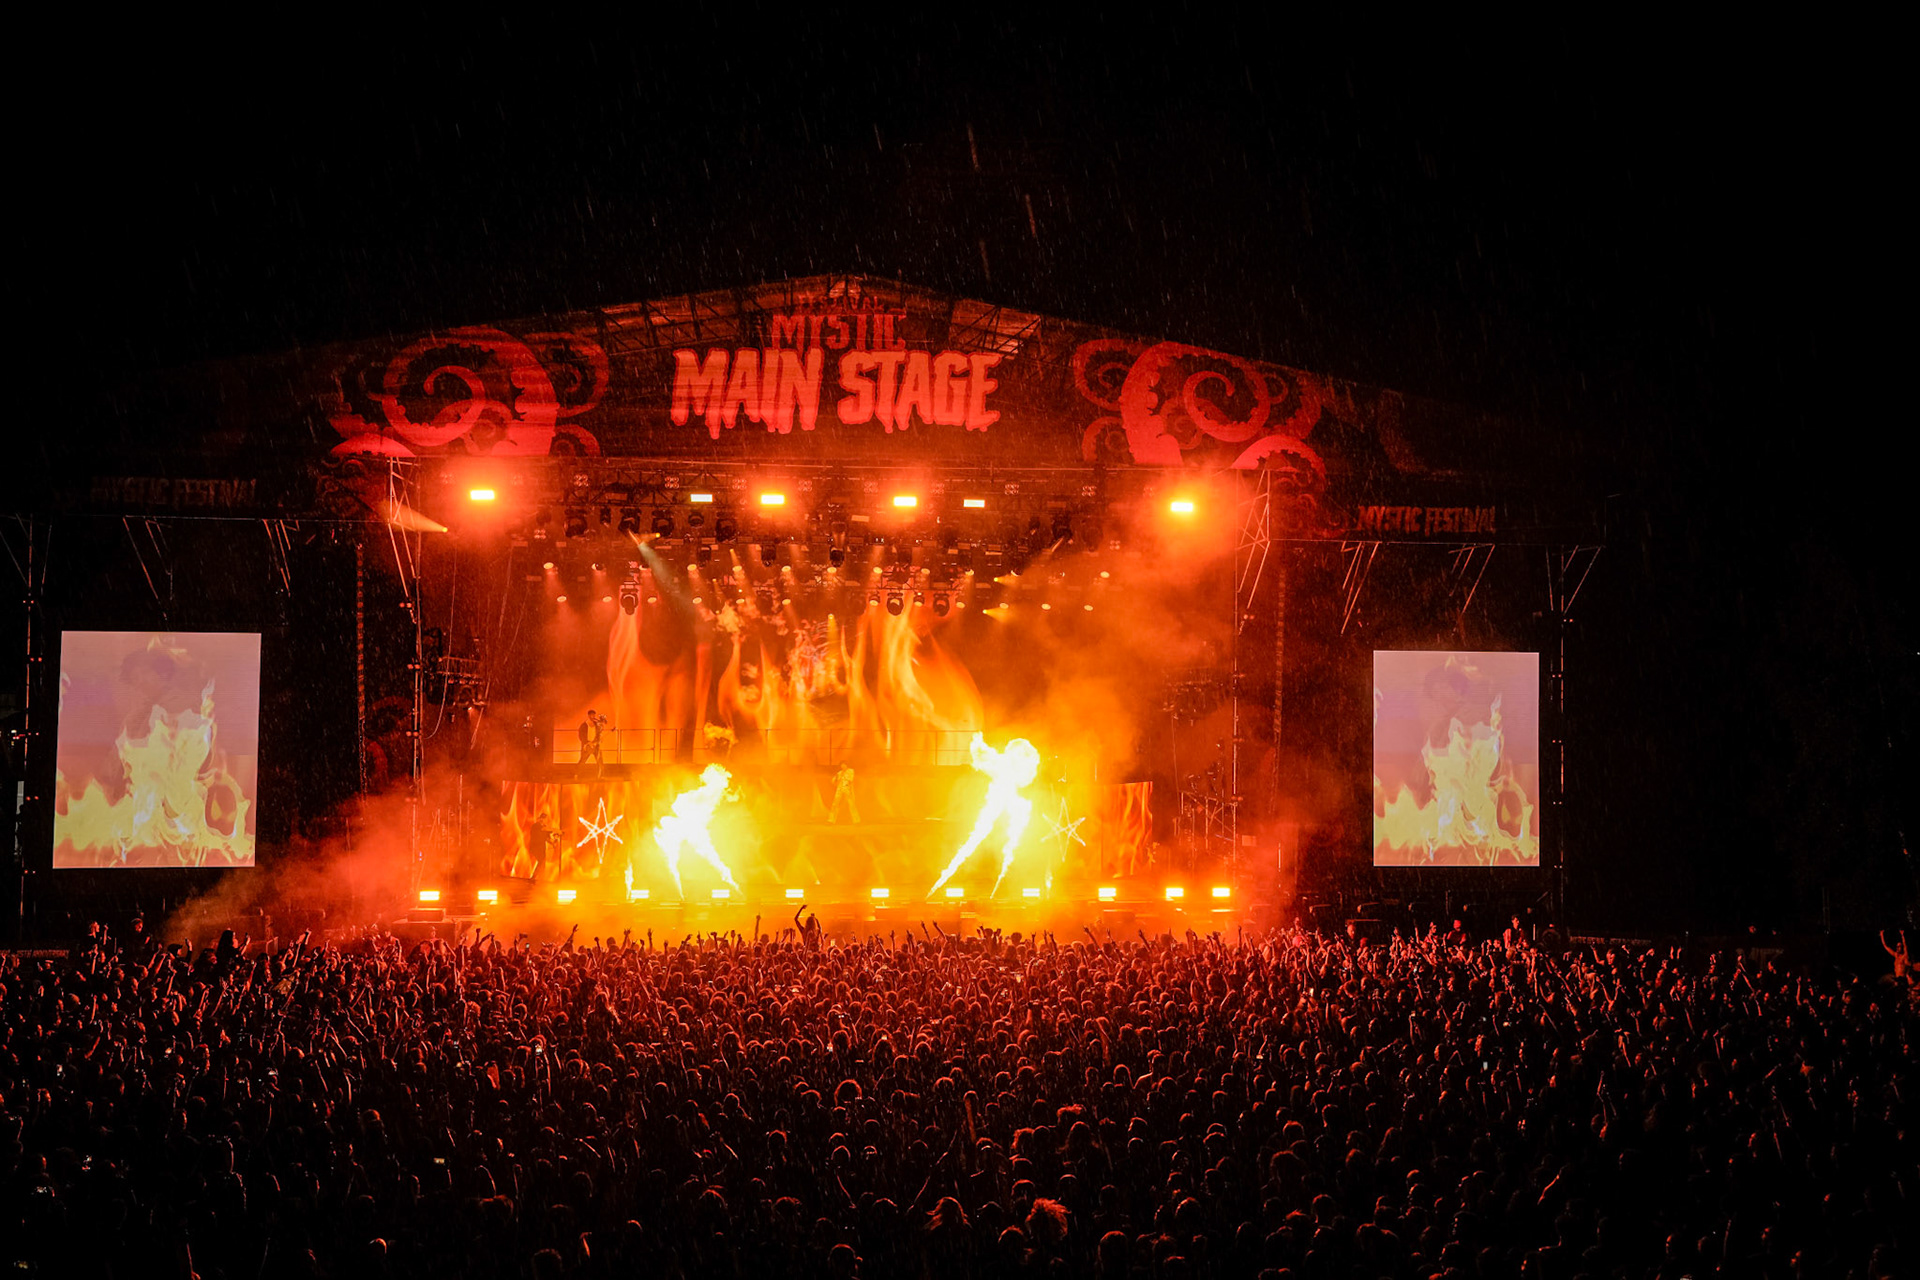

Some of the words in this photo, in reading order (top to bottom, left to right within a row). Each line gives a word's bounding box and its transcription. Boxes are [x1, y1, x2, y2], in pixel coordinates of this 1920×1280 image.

[772, 314, 906, 351] MYSTIC
[671, 348, 823, 439] MAIN
[838, 349, 1002, 433] STAGE
[1358, 505, 1423, 534] MYSTIC
[1425, 506, 1496, 537] FESTIVAL
